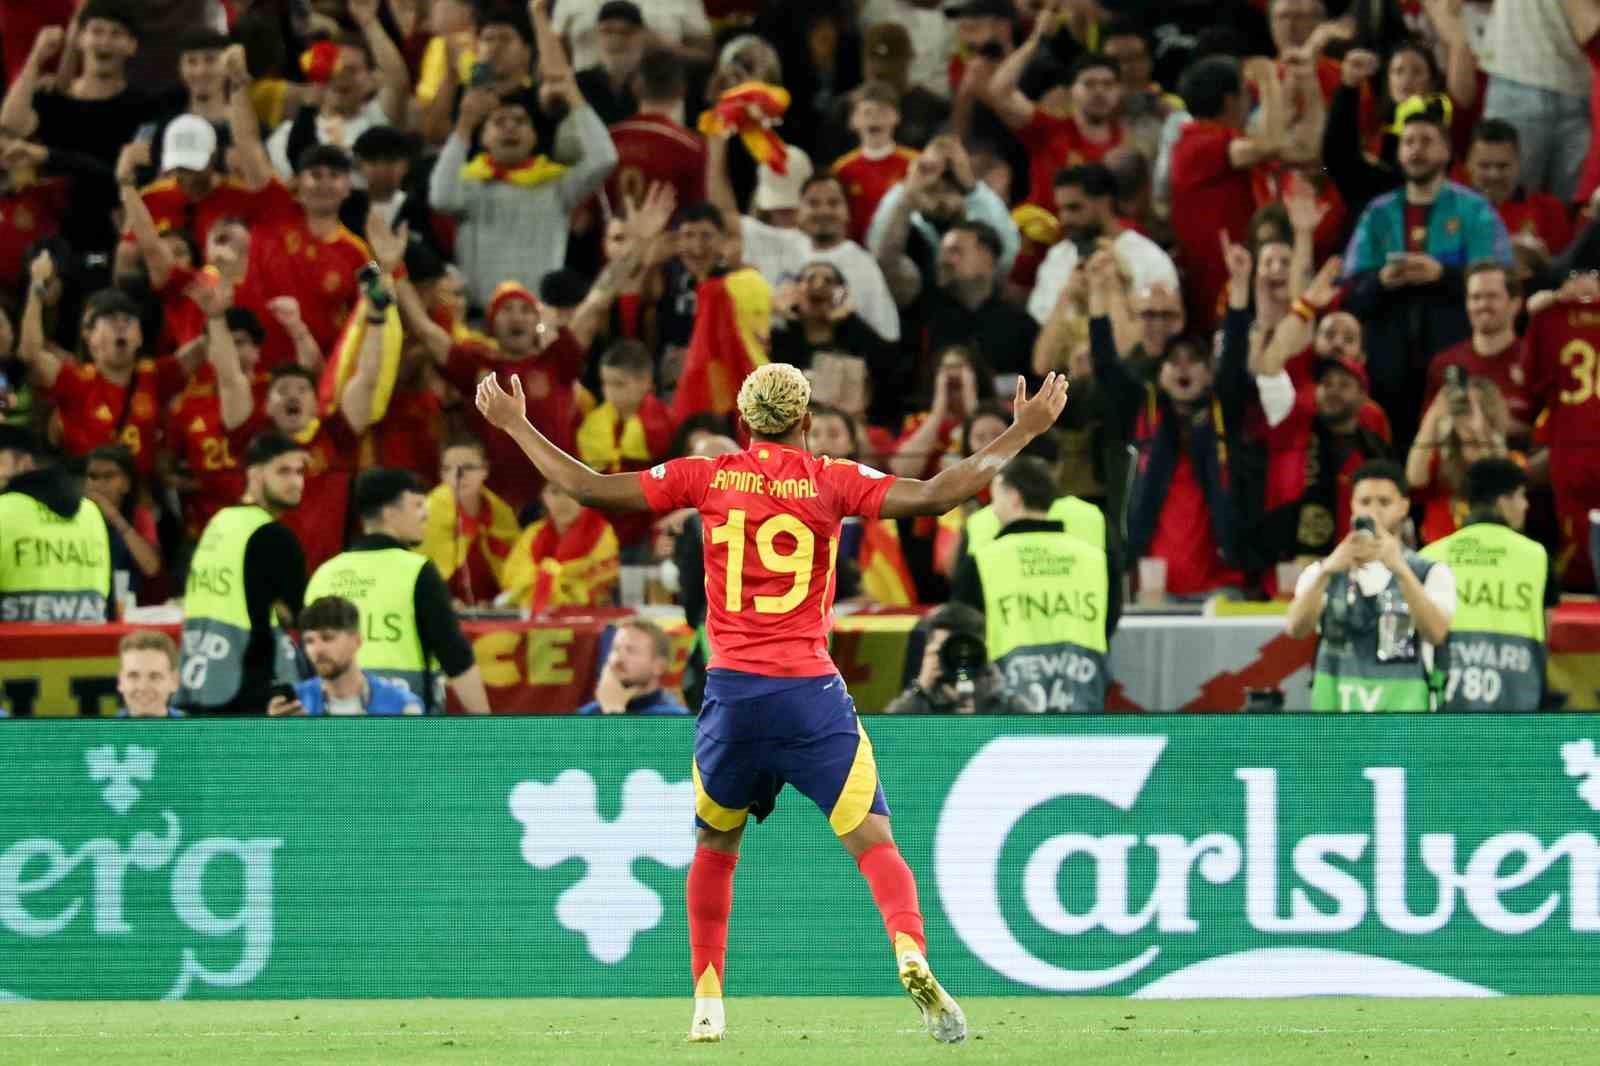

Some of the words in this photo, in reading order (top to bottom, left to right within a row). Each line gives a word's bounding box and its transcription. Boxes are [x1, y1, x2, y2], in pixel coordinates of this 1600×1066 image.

[709, 468, 766, 495] AMINE
[711, 507, 815, 614] 19
[1338, 684, 1382, 712] TV
